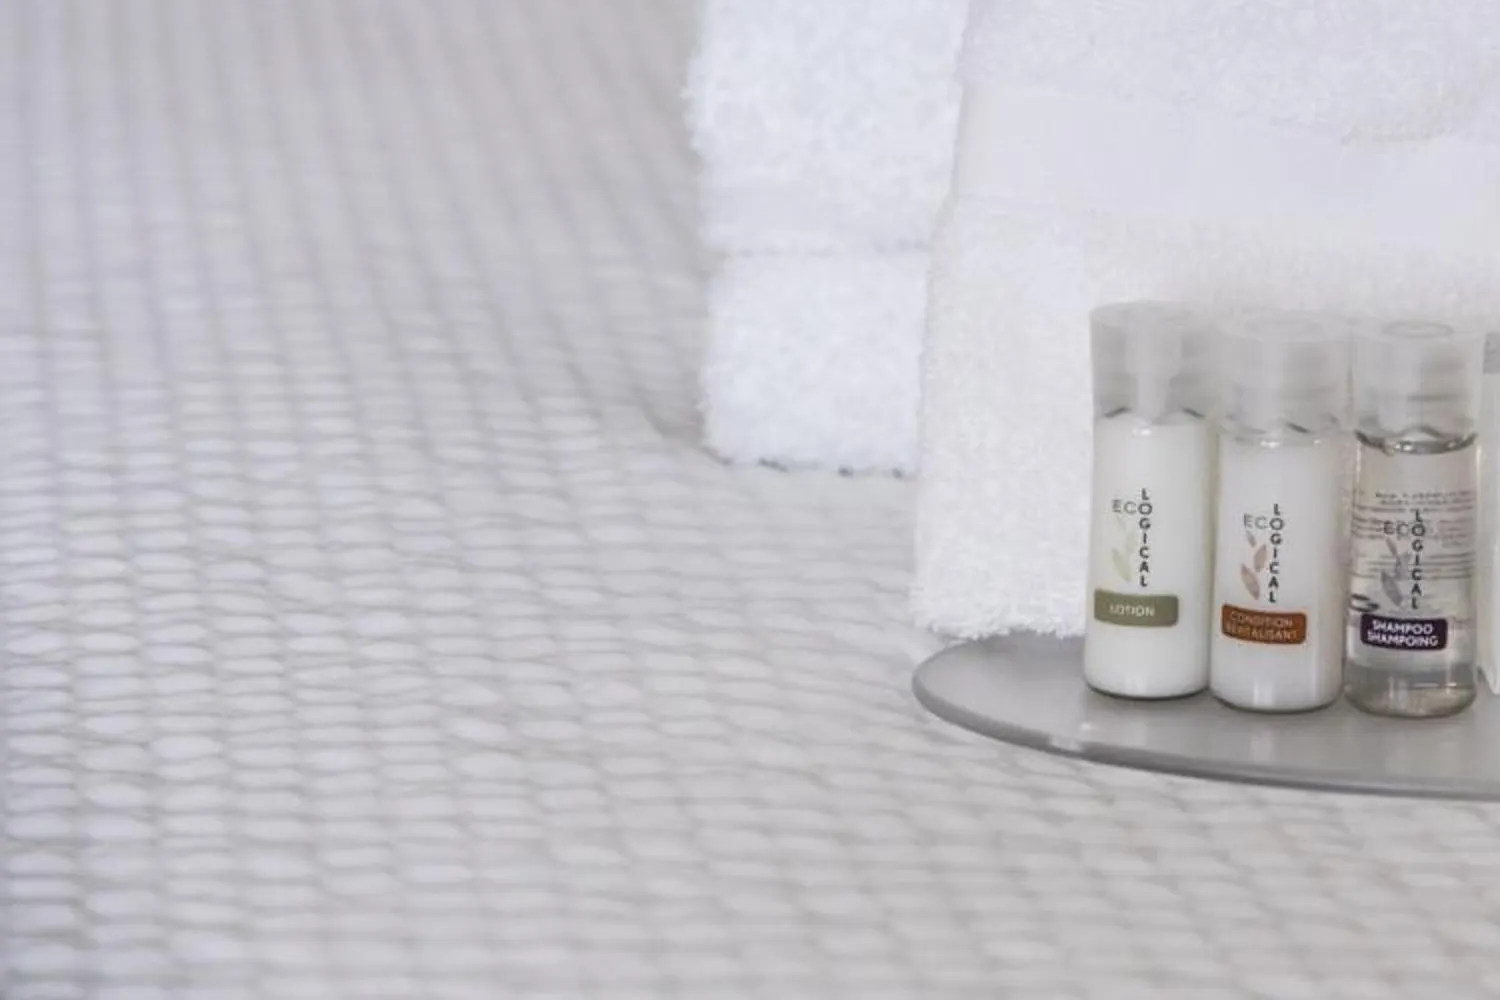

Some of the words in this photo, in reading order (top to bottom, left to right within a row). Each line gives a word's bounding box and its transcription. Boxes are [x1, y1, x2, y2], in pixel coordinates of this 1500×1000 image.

[1112, 498, 1153, 515] ECO
[1243, 513, 1285, 531] ECO
[1138, 487, 1153, 588] LOGICAL
[1268, 503, 1285, 604] LOGICAL
[1411, 508, 1426, 610] LOGICAL
[1109, 603, 1156, 617] LOTION
[1372, 619, 1434, 636] SHAMPOO
[1367, 629, 1439, 647] SHAMPOING
